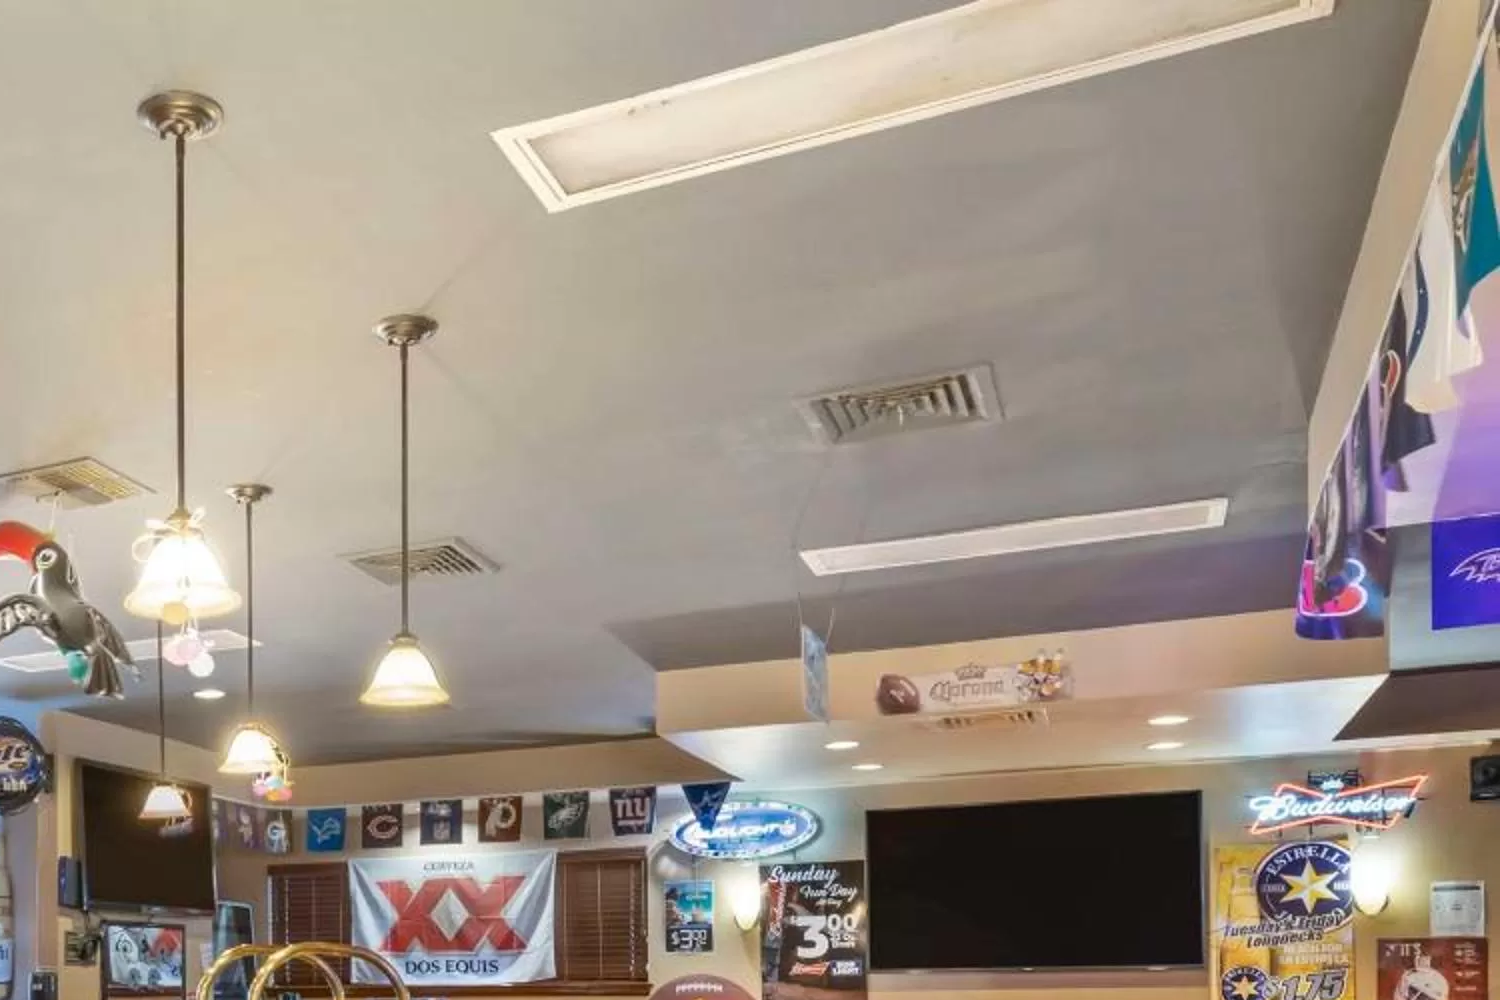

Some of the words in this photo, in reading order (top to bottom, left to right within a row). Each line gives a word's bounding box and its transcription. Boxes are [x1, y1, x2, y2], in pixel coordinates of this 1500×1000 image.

[928, 678, 1005, 702] Corona
[1249, 792, 1417, 821] Budweiser
[423, 861, 475, 872] CERVEZA
[1265, 845, 1351, 877] ESTRELLA
[769, 864, 839, 889] Sunday
[831, 882, 858, 901] Day
[376, 875, 527, 953] XX
[405, 961, 440, 976] DOS
[445, 959, 499, 976] EQUIS
